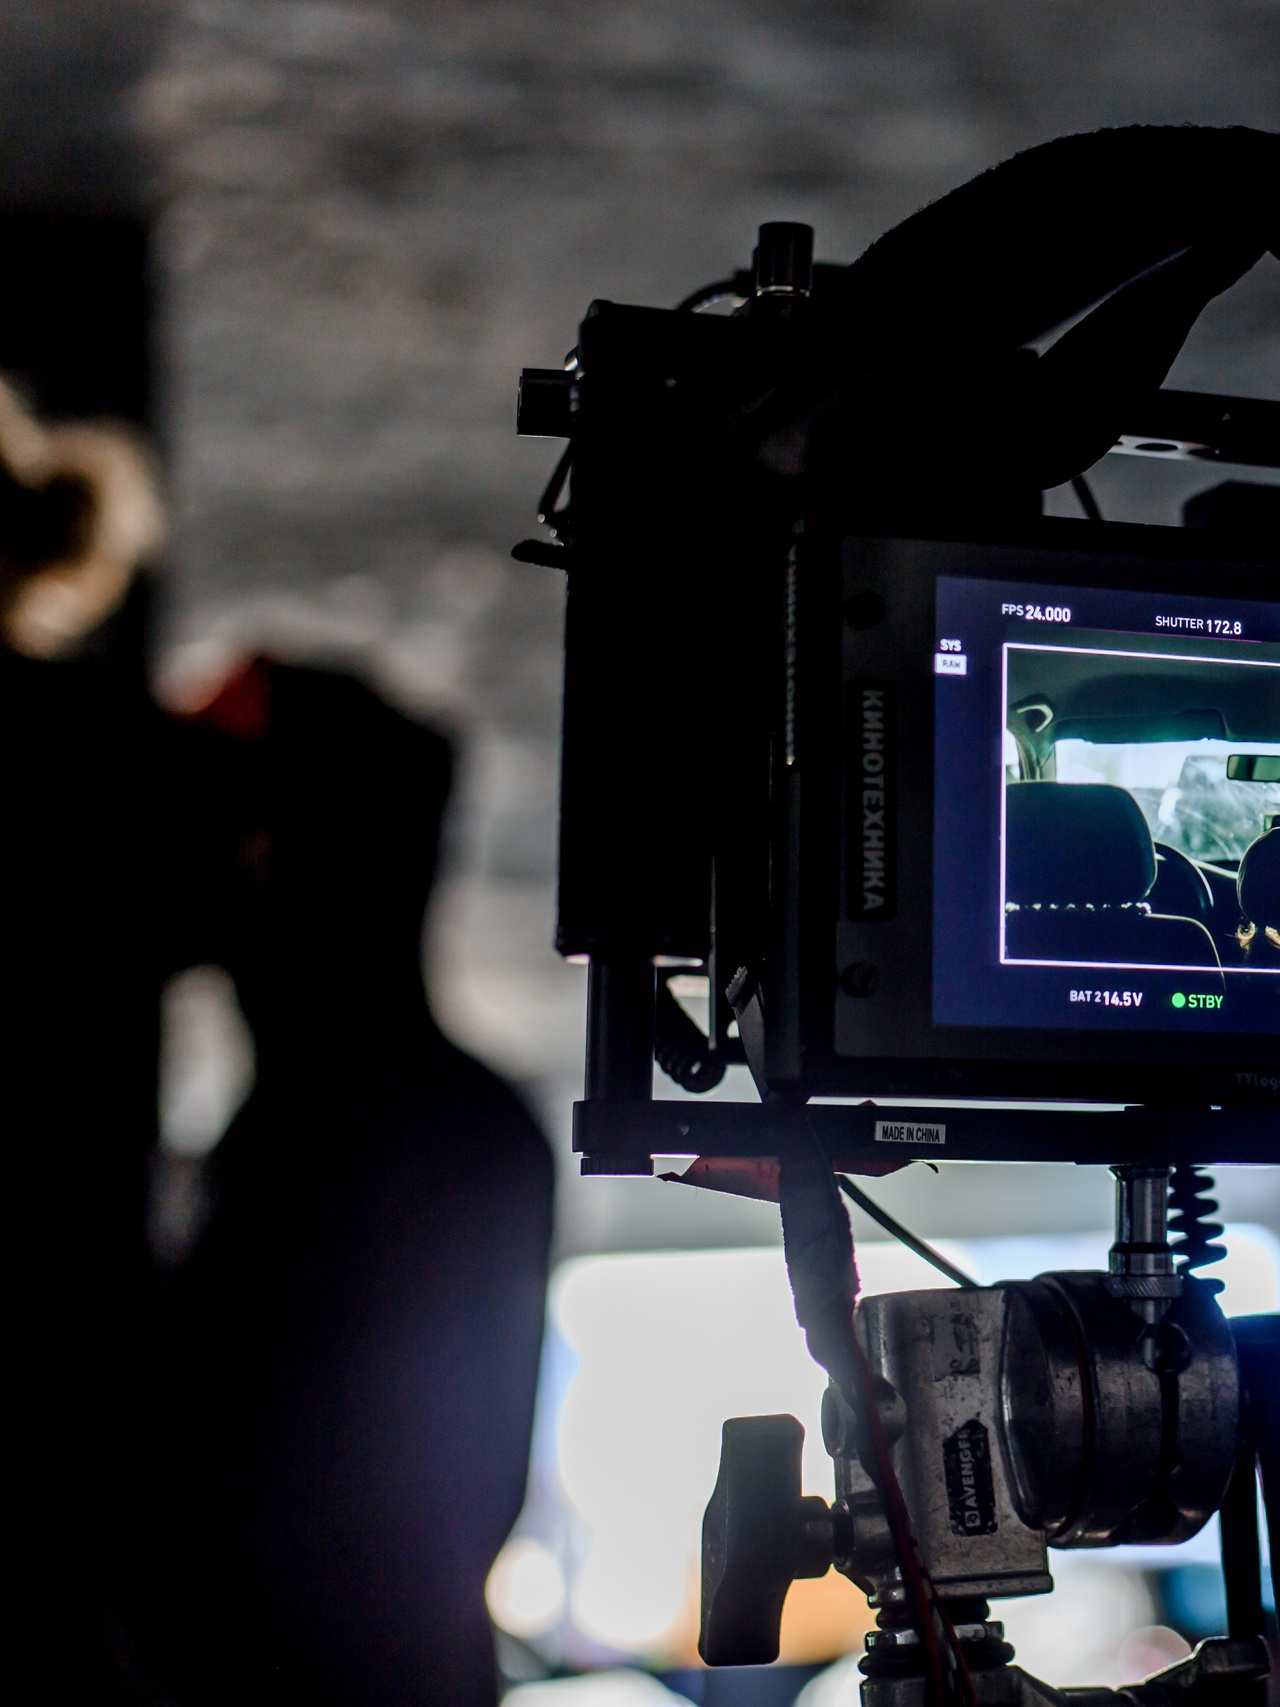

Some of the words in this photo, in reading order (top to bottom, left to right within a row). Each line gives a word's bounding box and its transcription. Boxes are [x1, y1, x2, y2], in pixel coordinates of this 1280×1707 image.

[1001, 603, 1024, 616] FPS
[1025, 605, 1071, 623] 24.000
[1155, 616, 1204, 630] SHUTTER
[1206, 619, 1242, 635] 172.8
[940, 639, 962, 652] SYS
[942, 659, 961, 670] RAW
[862, 690, 885, 911] КИНОТЕХНИКА
[1069, 990, 1092, 1002] BAT
[1094, 991, 1102, 1003] 2
[1103, 991, 1143, 1007] 14.5V
[1188, 994, 1224, 1009] STBY
[881, 1126, 905, 1141] MADE
[906, 1127, 915, 1141] IN
[916, 1128, 940, 1143] CHINA
